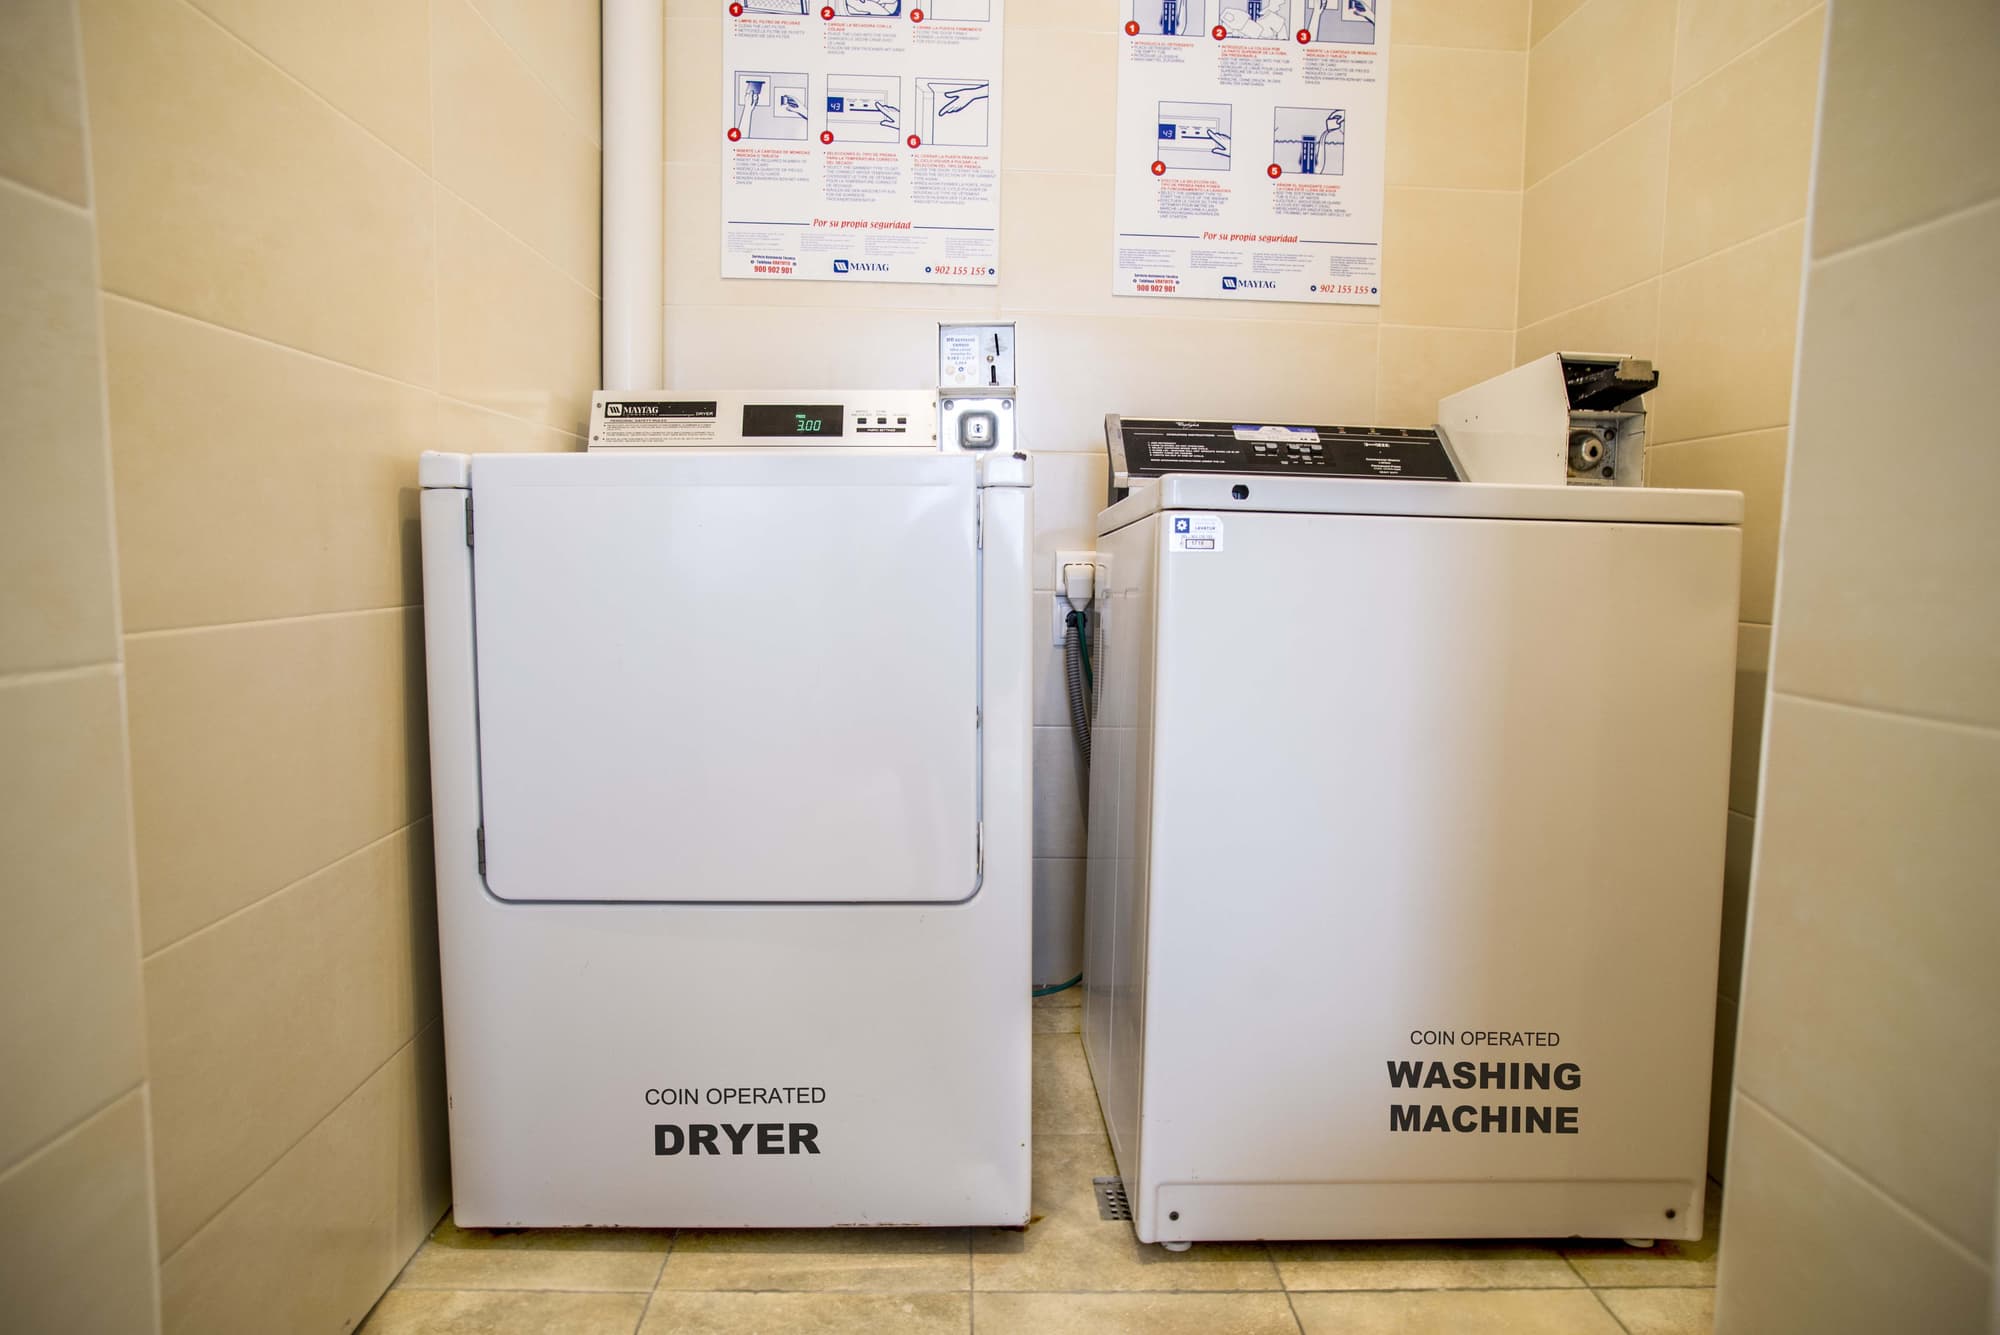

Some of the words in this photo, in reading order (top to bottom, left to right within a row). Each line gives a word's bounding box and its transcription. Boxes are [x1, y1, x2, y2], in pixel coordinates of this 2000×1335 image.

[824, 9, 831, 17] 2
[914, 12, 920, 20] 3
[1129, 25, 1135, 33] 1
[1216, 29, 1222, 37] 2
[1301, 33, 1307, 41] 3
[1155, 164, 1162, 173] 4
[1272, 167, 1278, 175] 5
[813, 218, 827, 227] Por
[841, 219, 868, 229] propia
[871, 220, 911, 230] seguridad
[1203, 231, 1217, 240] Por
[1230, 232, 1256, 242] propia
[1259, 234, 1298, 243] seguridad
[754, 265, 766, 273] 900
[768, 266, 779, 274] 902
[850, 262, 889, 272] MAYTAG
[934, 265, 950, 275] 902
[953, 266, 967, 275] 155
[971, 267, 985, 276] 155
[1151, 285, 1162, 293] 902
[1164, 285, 1176, 293] 901
[1238, 279, 1276, 289] MAYTAG
[1320, 284, 1335, 293] 902
[1338, 285, 1352, 294] 155
[1355, 286, 1369, 295] 155
[624, 406, 659, 414] MAYTAG
[796, 420, 821, 432] 3.00
[1411, 1030, 1455, 1046] COIN
[1461, 1031, 1560, 1047] OPERATED
[1387, 1061, 1581, 1090] WASHING
[646, 1088, 698, 1105] COIN
[707, 1087, 826, 1105] OPERATED
[1390, 1104, 1579, 1134] MACHINE
[655, 1123, 821, 1156] DRYER
